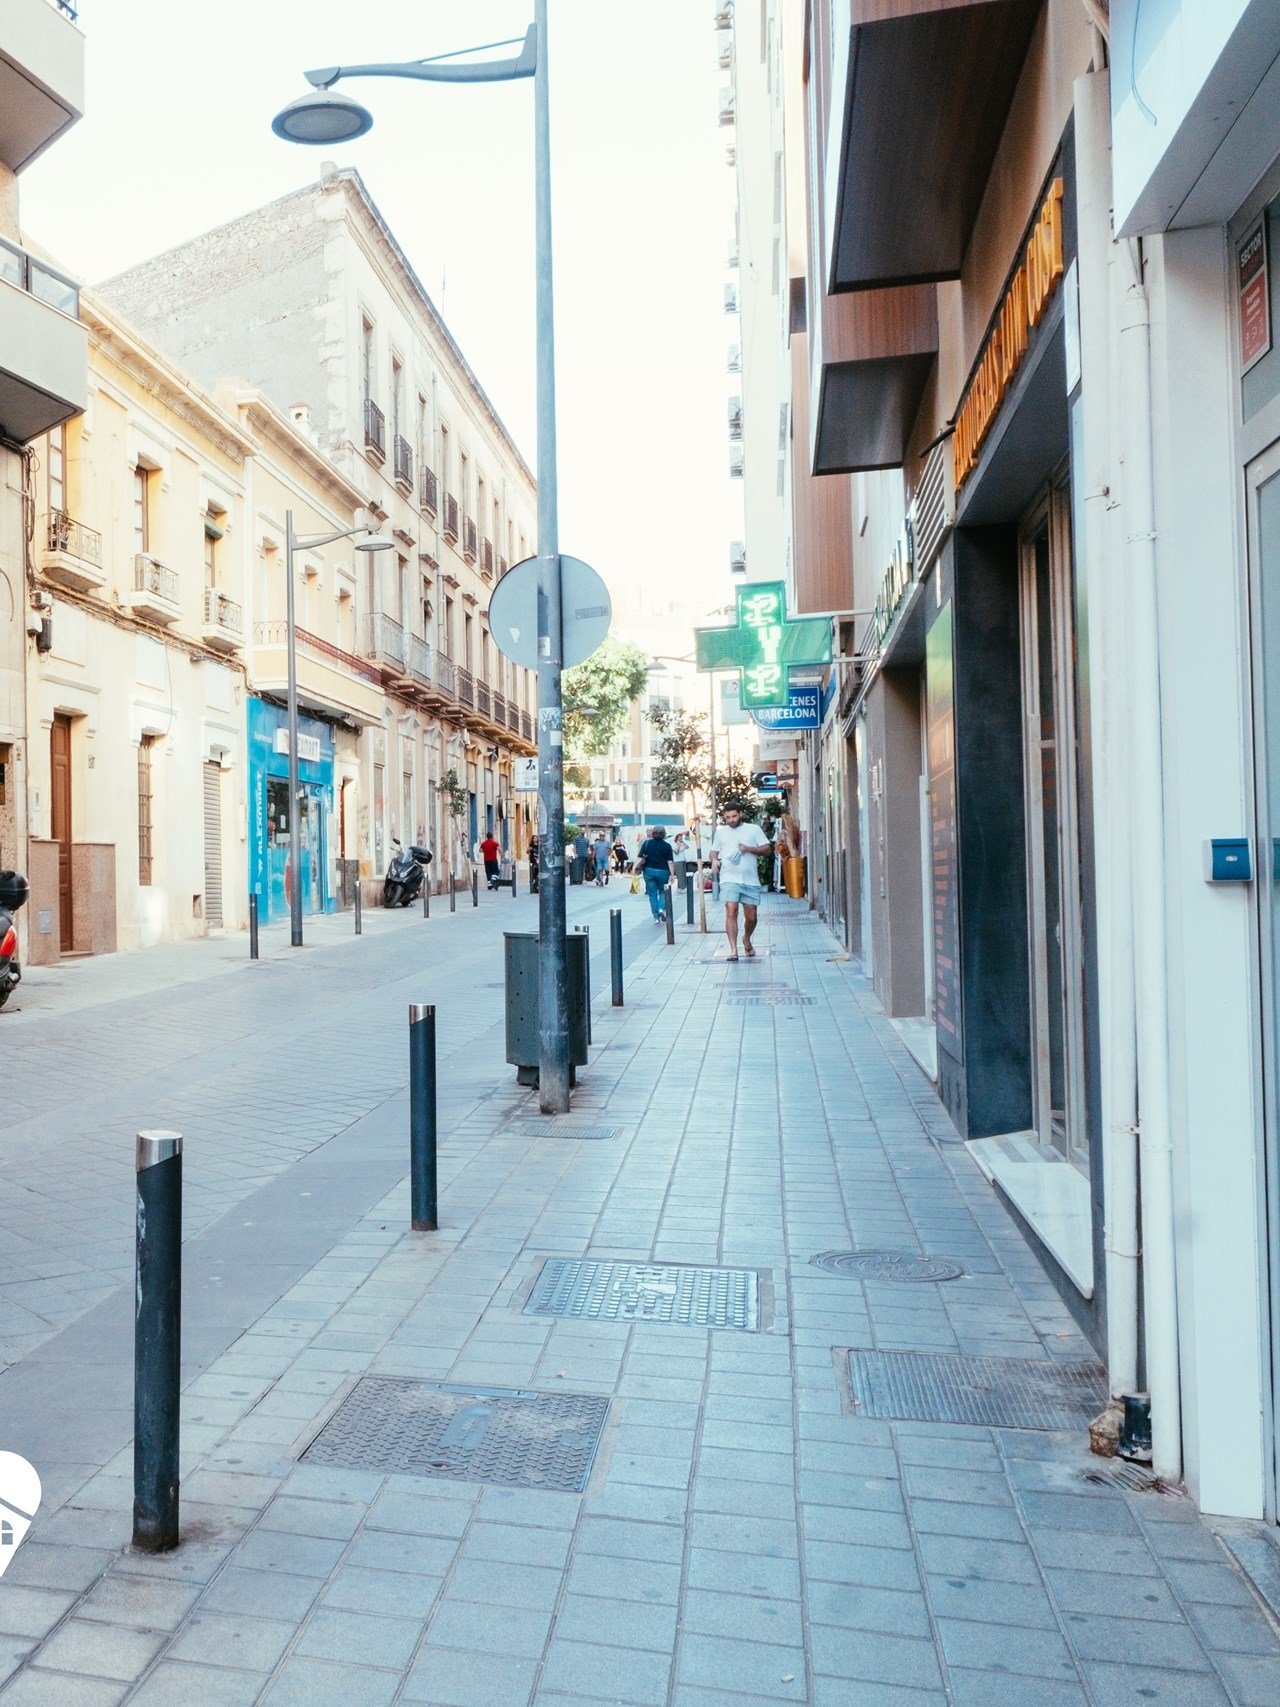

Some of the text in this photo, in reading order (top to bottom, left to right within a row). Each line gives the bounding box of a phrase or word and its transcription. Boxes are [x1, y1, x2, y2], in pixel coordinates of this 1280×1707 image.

[1027, 178, 1064, 326] COST
[1241, 232, 1262, 267] SECTOR
[759, 708, 817, 720] BARCELONA
